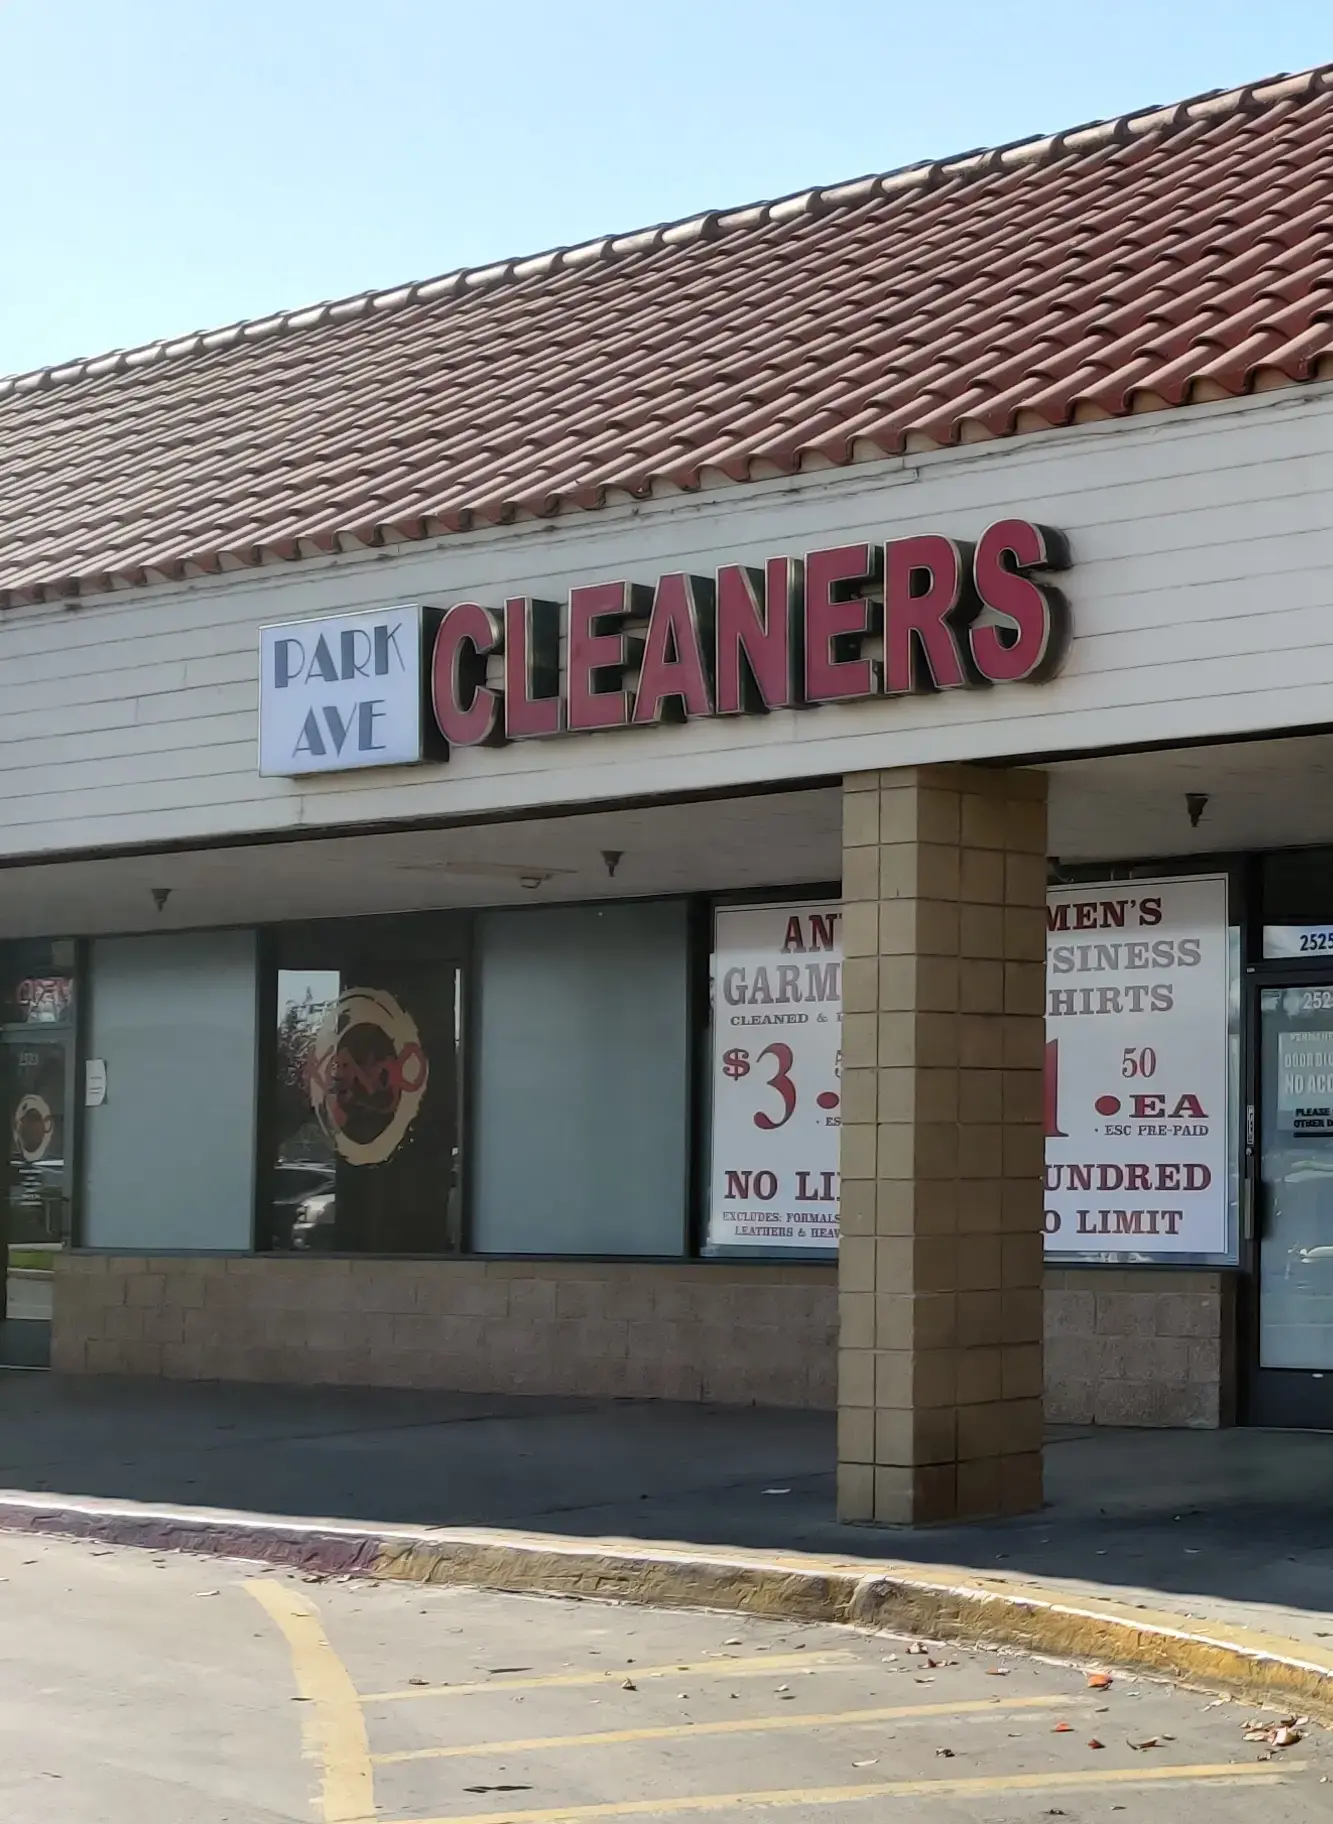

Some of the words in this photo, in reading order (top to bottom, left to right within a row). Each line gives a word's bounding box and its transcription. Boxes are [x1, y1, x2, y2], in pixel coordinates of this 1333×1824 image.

[432, 518, 1055, 748] CLEANERS
[273, 619, 404, 690] PARK
[292, 697, 388, 760] AVE
[1046, 897, 1162, 932] MEN'S
[780, 913, 842, 953] AN
[1048, 938, 1202, 974] SINESS
[723, 963, 841, 1006] GARM
[1048, 983, 1174, 1016] HIRTS
[730, 1012, 809, 1026] CLEANED
[816, 1012, 829, 1023] &
[1121, 1047, 1157, 1078] 50
[1285, 1073, 1304, 1094] NO
[1129, 1094, 1209, 1118] EA
[1295, 1107, 1330, 1117] PLEASE
[825, 1117, 841, 1126] ES
[1104, 1125, 1132, 1136] ESC
[1137, 1124, 1209, 1136] PRE-PAID
[1294, 1118, 1324, 1128] OTHER
[724, 1170, 778, 1200] NO
[795, 1171, 840, 1201] LI
[1044, 1163, 1212, 1191] UNDRED
[723, 1211, 783, 1223] EXCLUDES:
[1044, 1210, 1062, 1234] O
[1076, 1210, 1184, 1235] LIMIT
[735, 1225, 794, 1237] LEATHERS
[797, 1228, 806, 1237] &
[810, 1228, 841, 1238] HEAV
